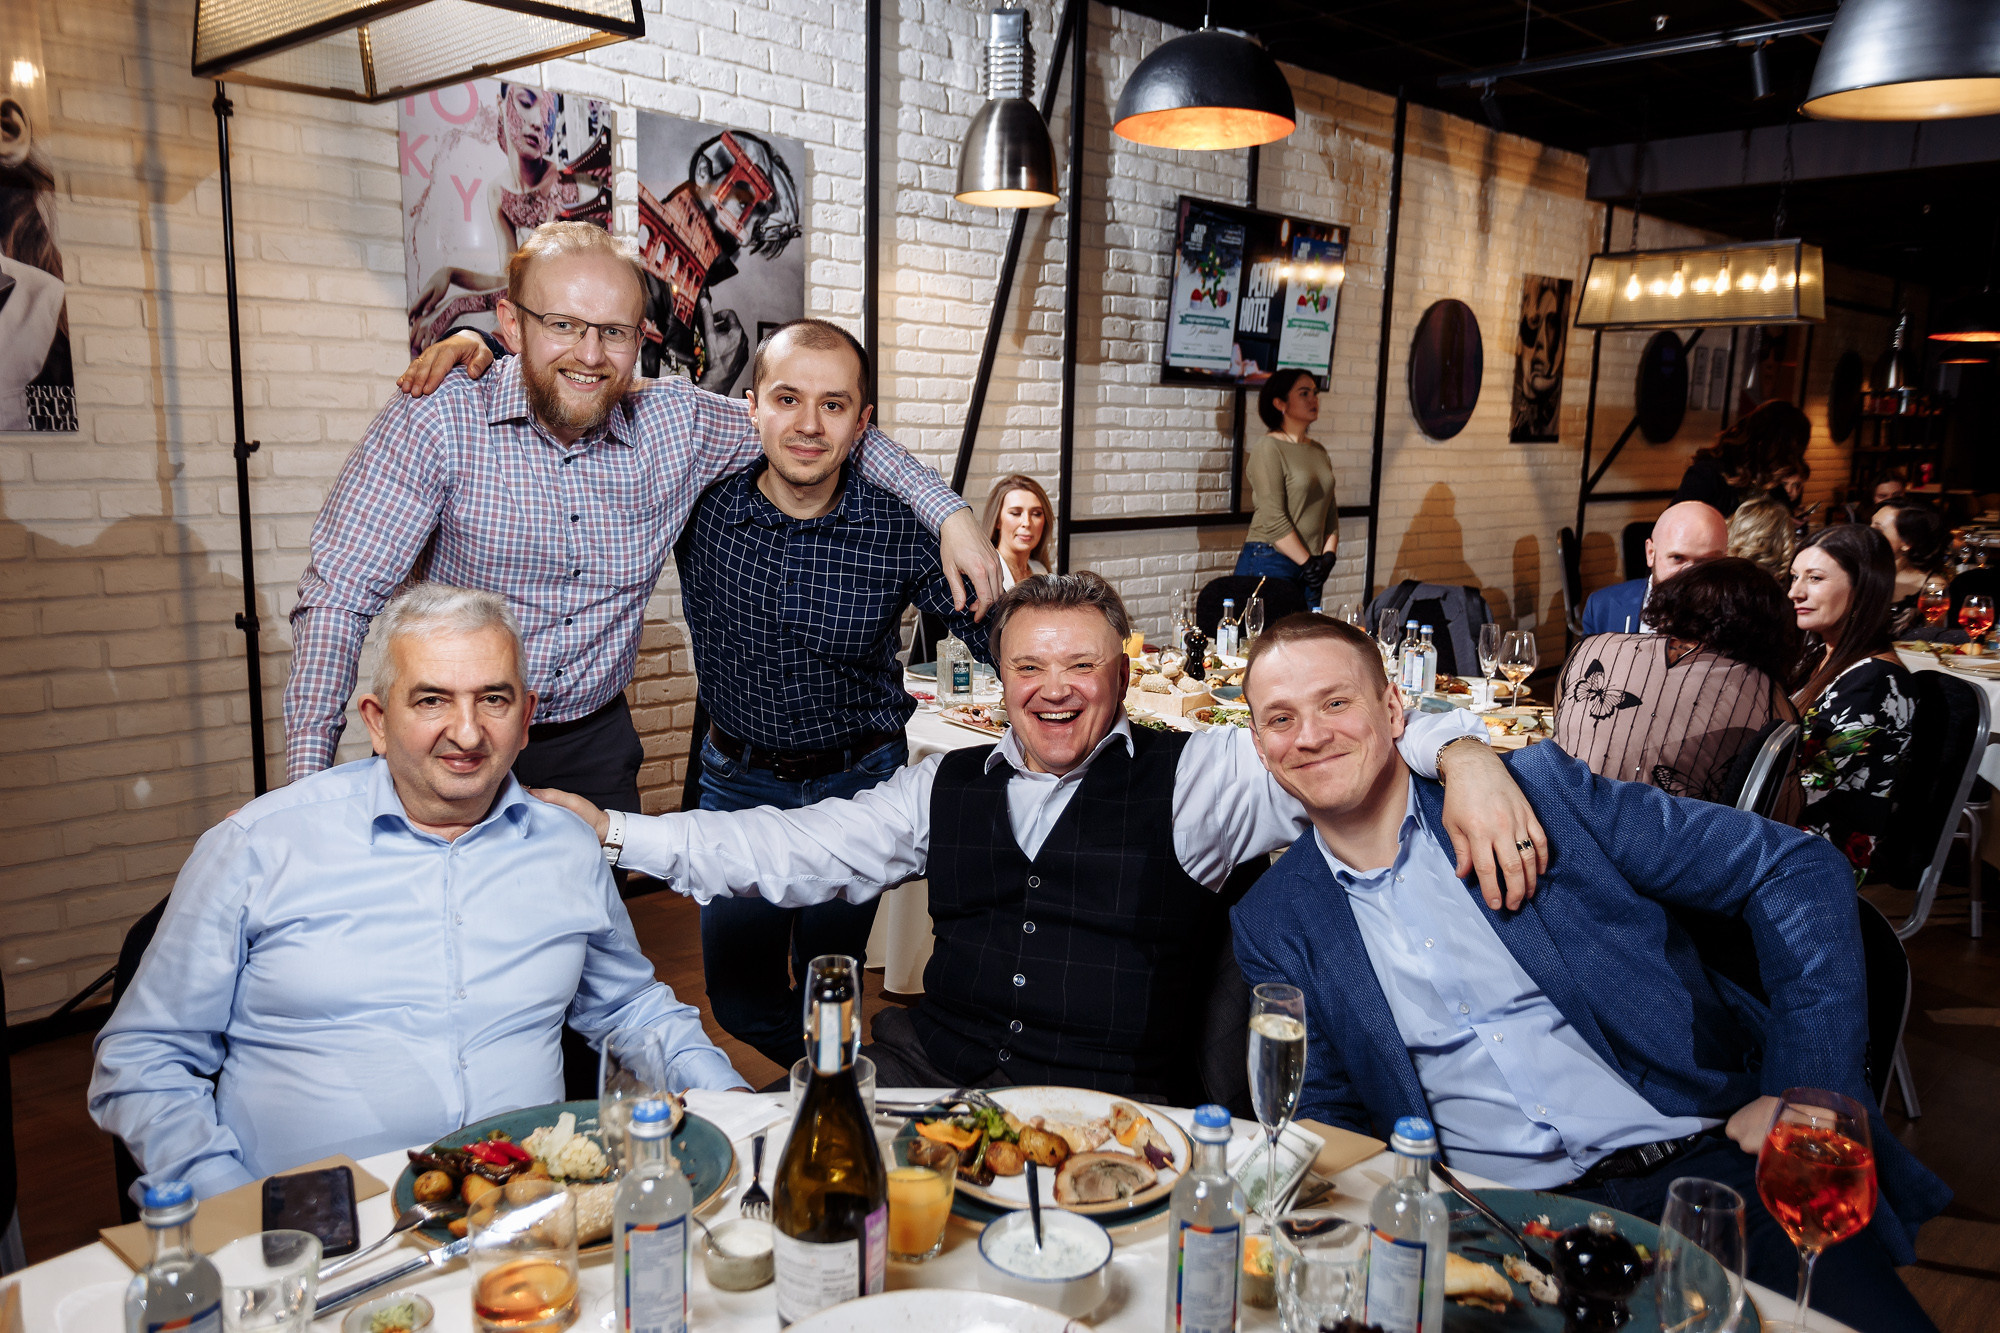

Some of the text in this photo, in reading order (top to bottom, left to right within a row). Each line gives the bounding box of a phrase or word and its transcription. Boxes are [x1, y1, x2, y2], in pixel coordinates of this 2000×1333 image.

[400, 131, 432, 179] K
[450, 174, 482, 222] Y
[1238, 297, 1271, 334] HOTEL
